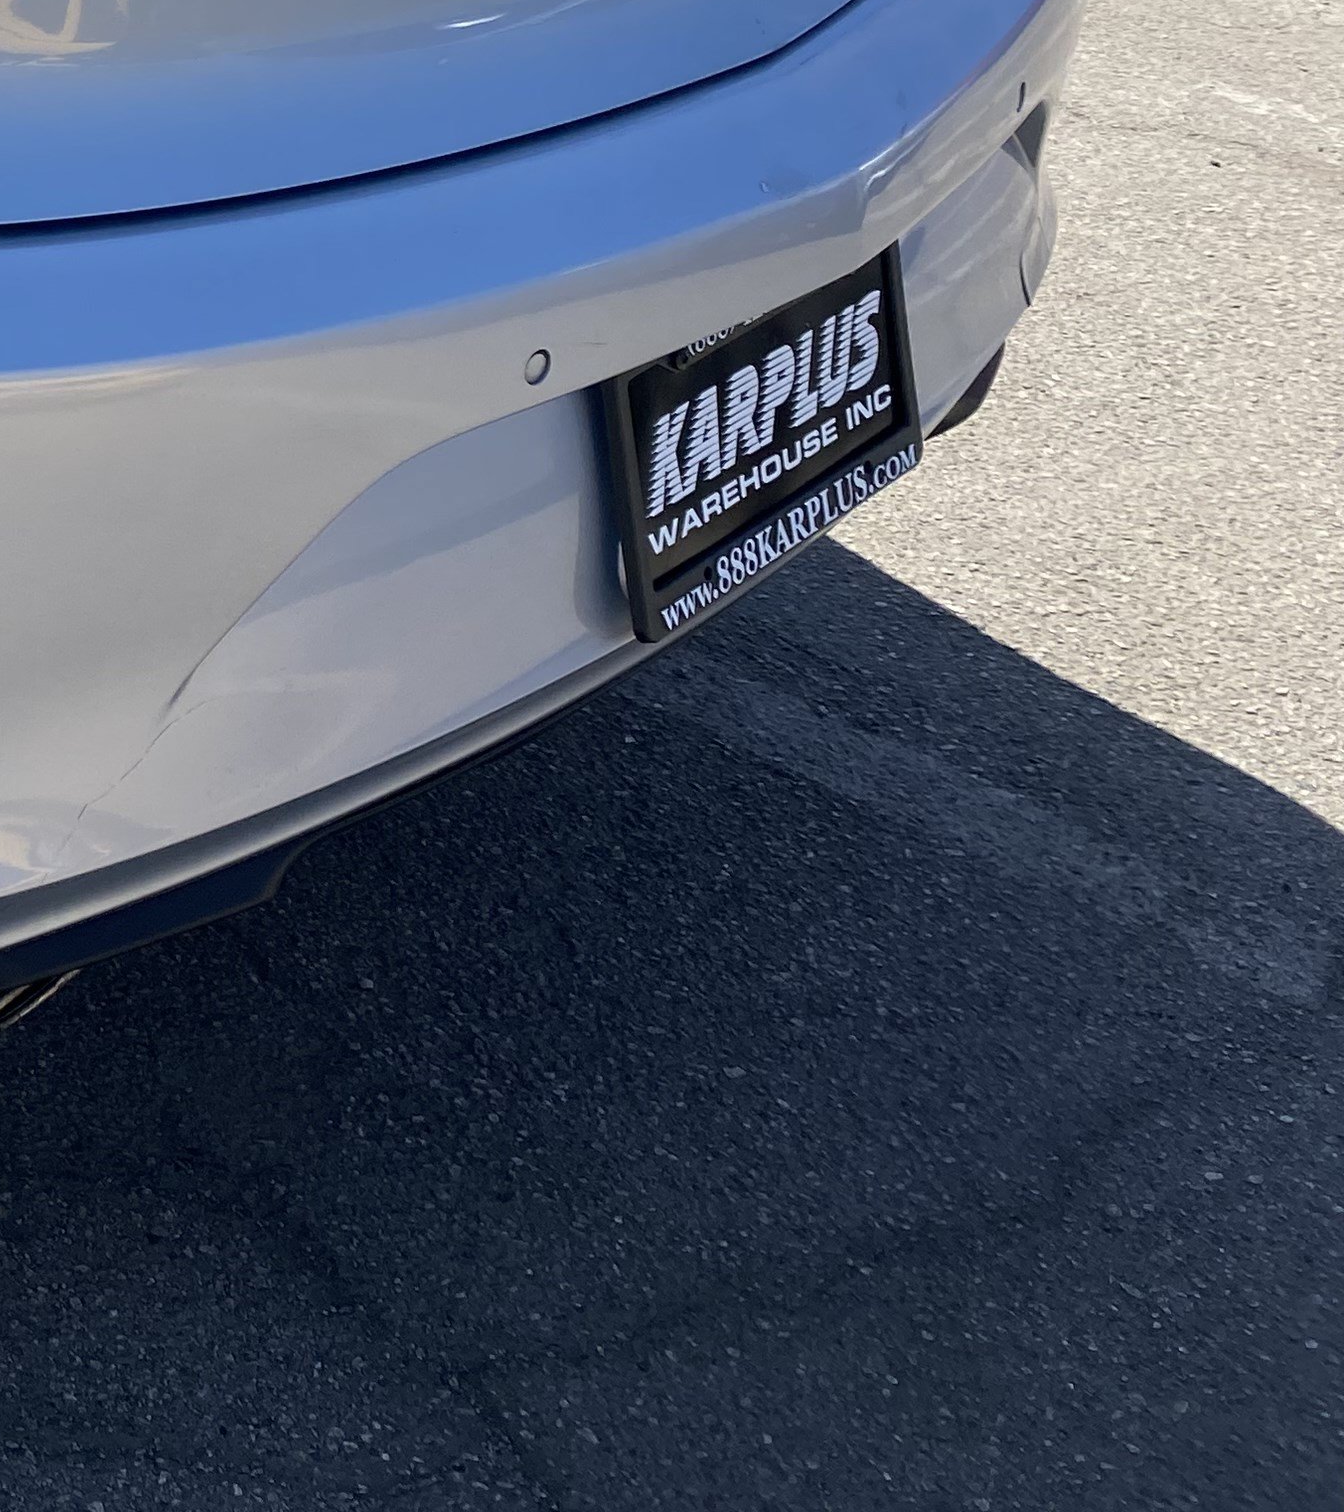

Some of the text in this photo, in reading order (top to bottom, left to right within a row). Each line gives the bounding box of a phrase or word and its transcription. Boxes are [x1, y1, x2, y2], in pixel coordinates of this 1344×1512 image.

[645, 289, 882, 520] KARPLUS
[647, 383, 893, 556] WAREHOUSE INC
